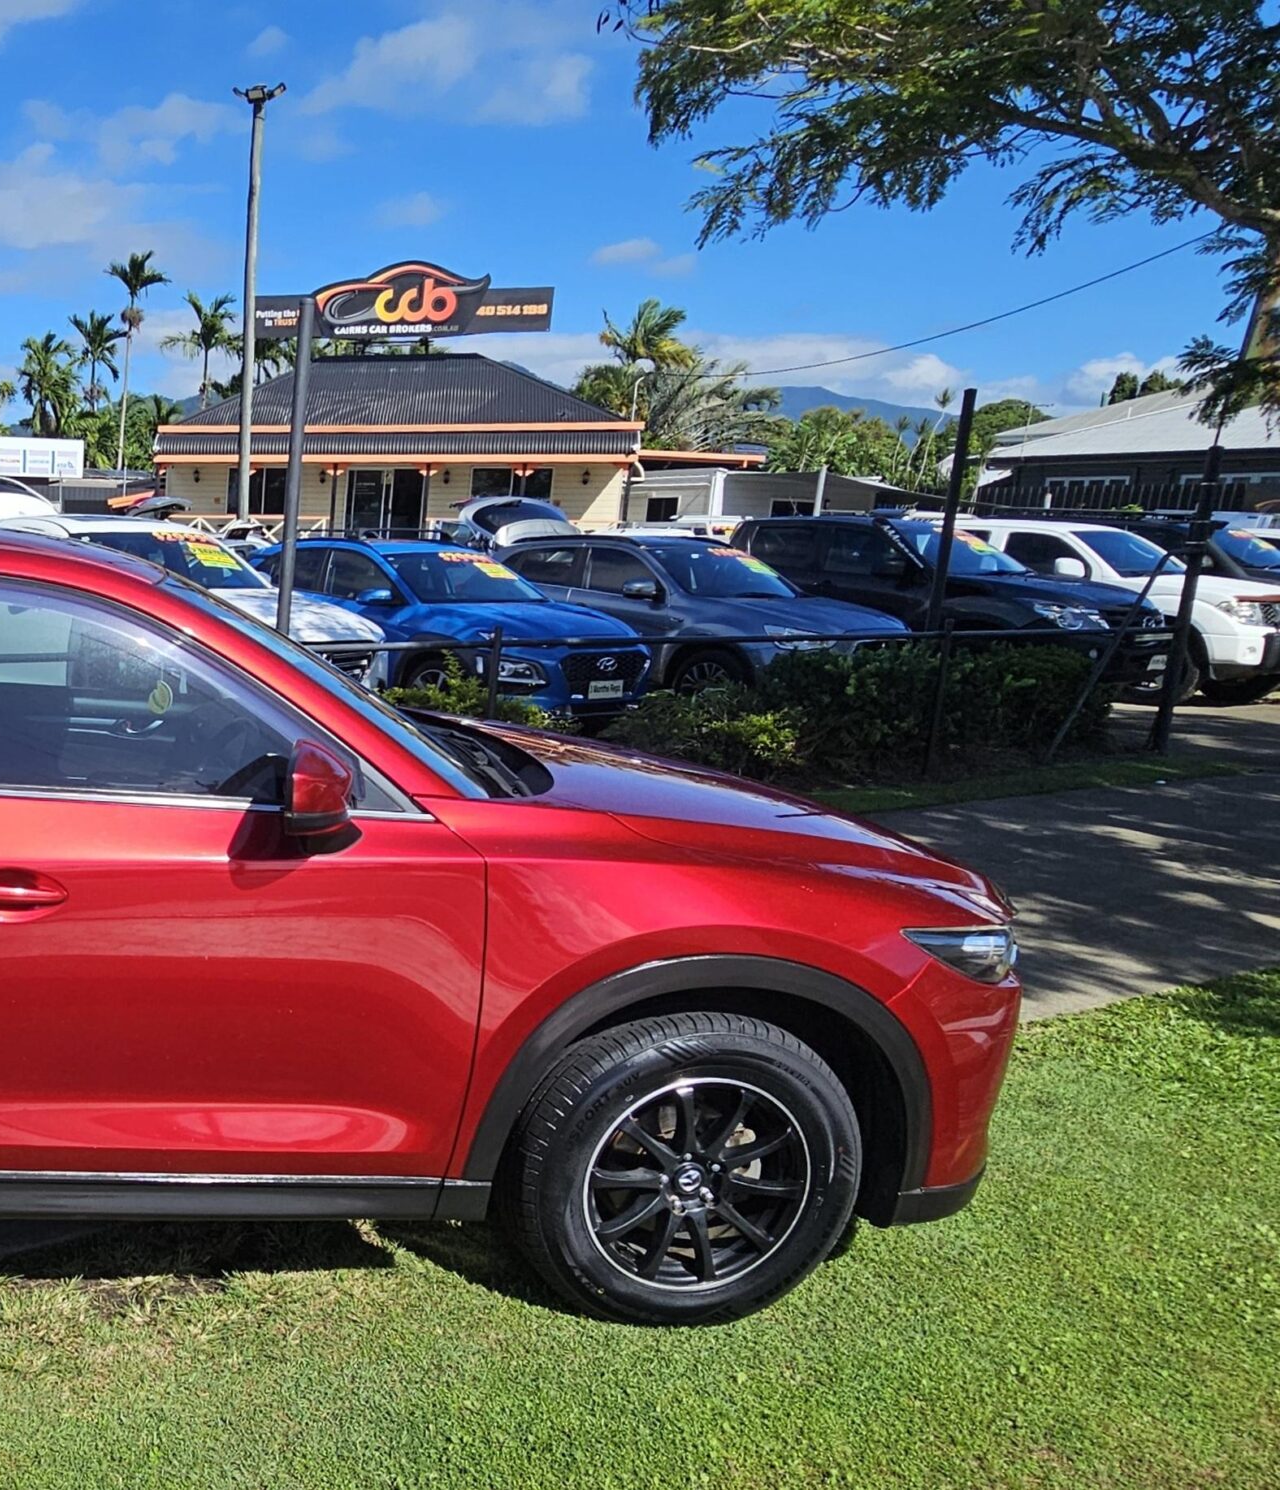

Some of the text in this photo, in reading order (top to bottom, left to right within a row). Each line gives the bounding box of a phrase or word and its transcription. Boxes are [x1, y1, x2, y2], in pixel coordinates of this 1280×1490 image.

[273, 318, 297, 326] TRUST
[334, 324, 368, 335] CAIRNS
[369, 325, 388, 334] CAR
